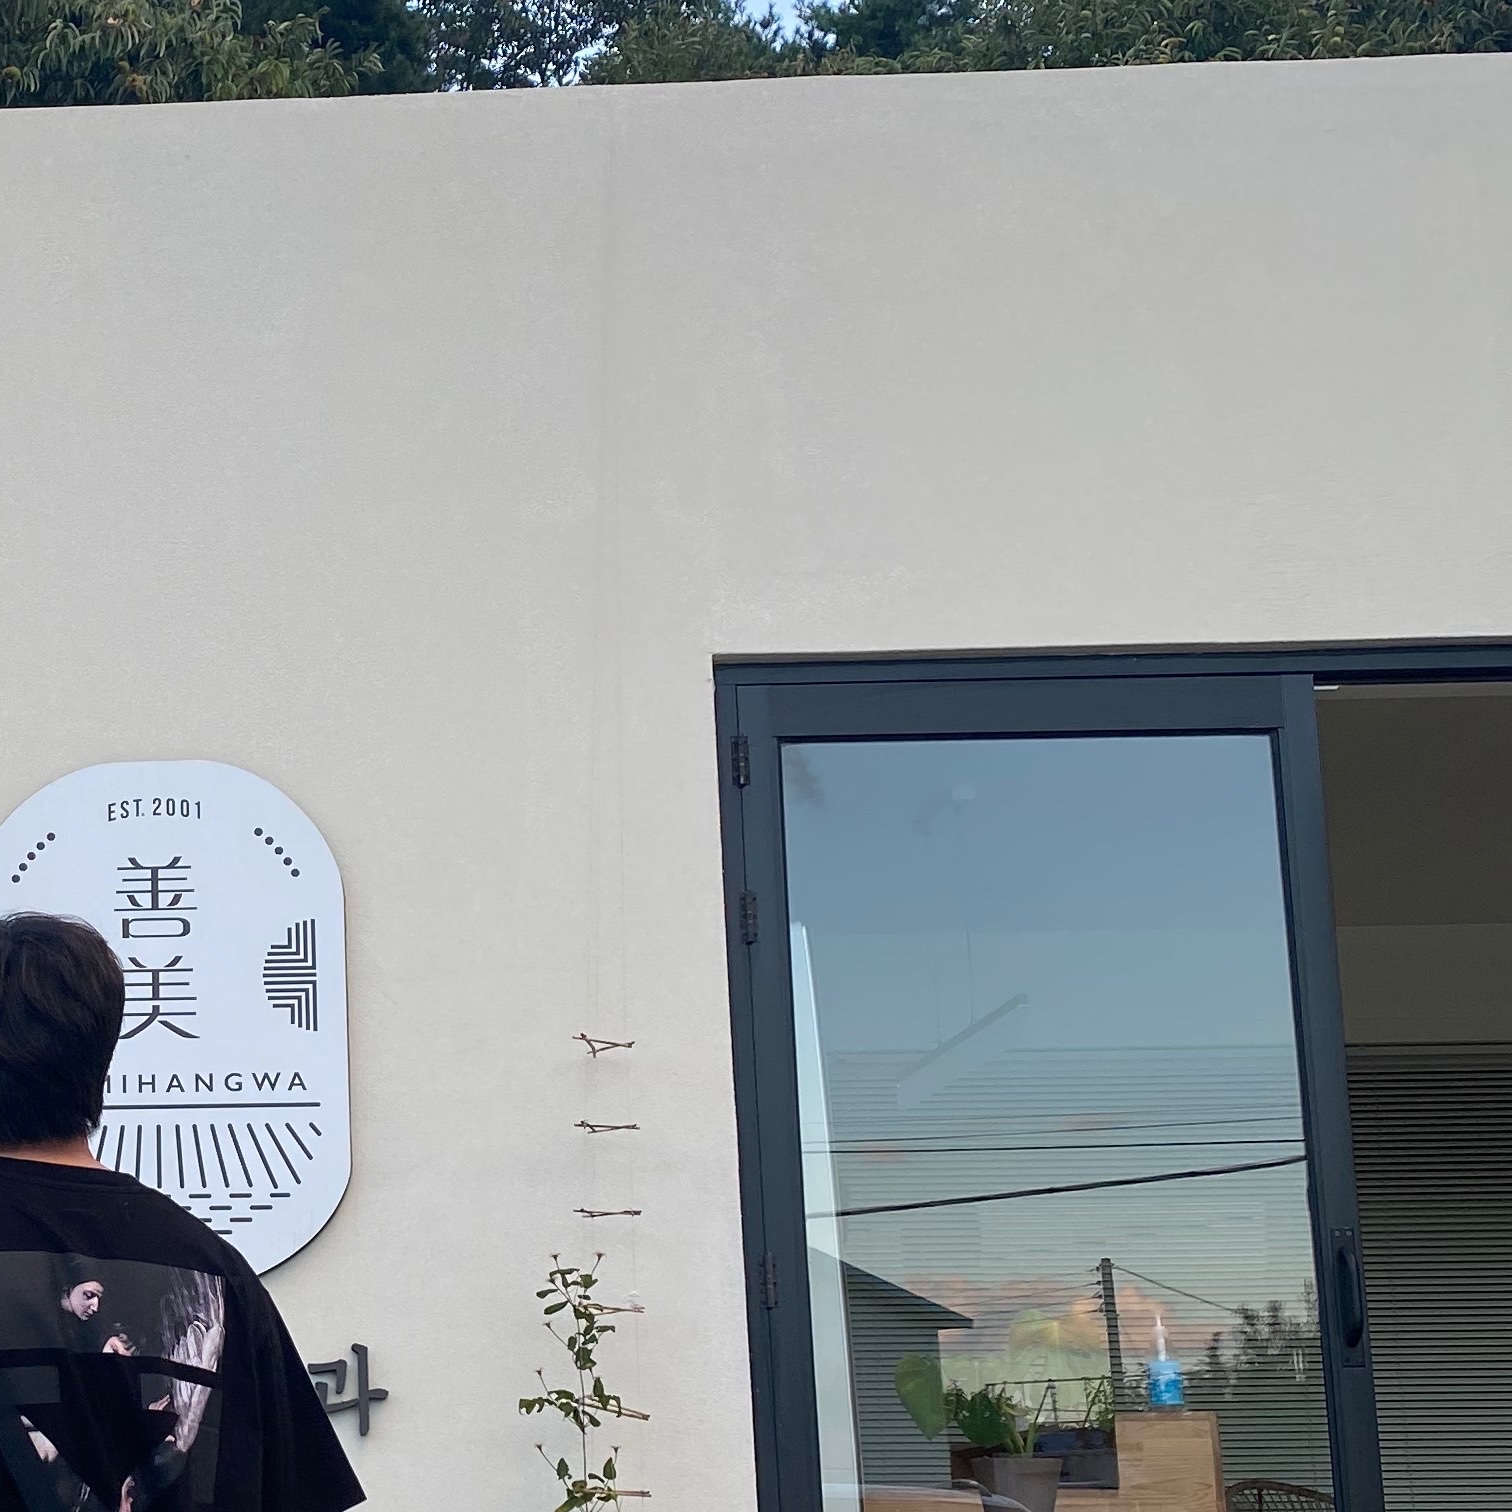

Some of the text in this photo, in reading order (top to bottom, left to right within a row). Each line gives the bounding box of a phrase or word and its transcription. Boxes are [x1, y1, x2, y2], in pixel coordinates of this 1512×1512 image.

[108, 798, 201, 822] EST. 2001
[114, 856, 200, 1040] 善美
[308, 1343, 389, 1437] 과
